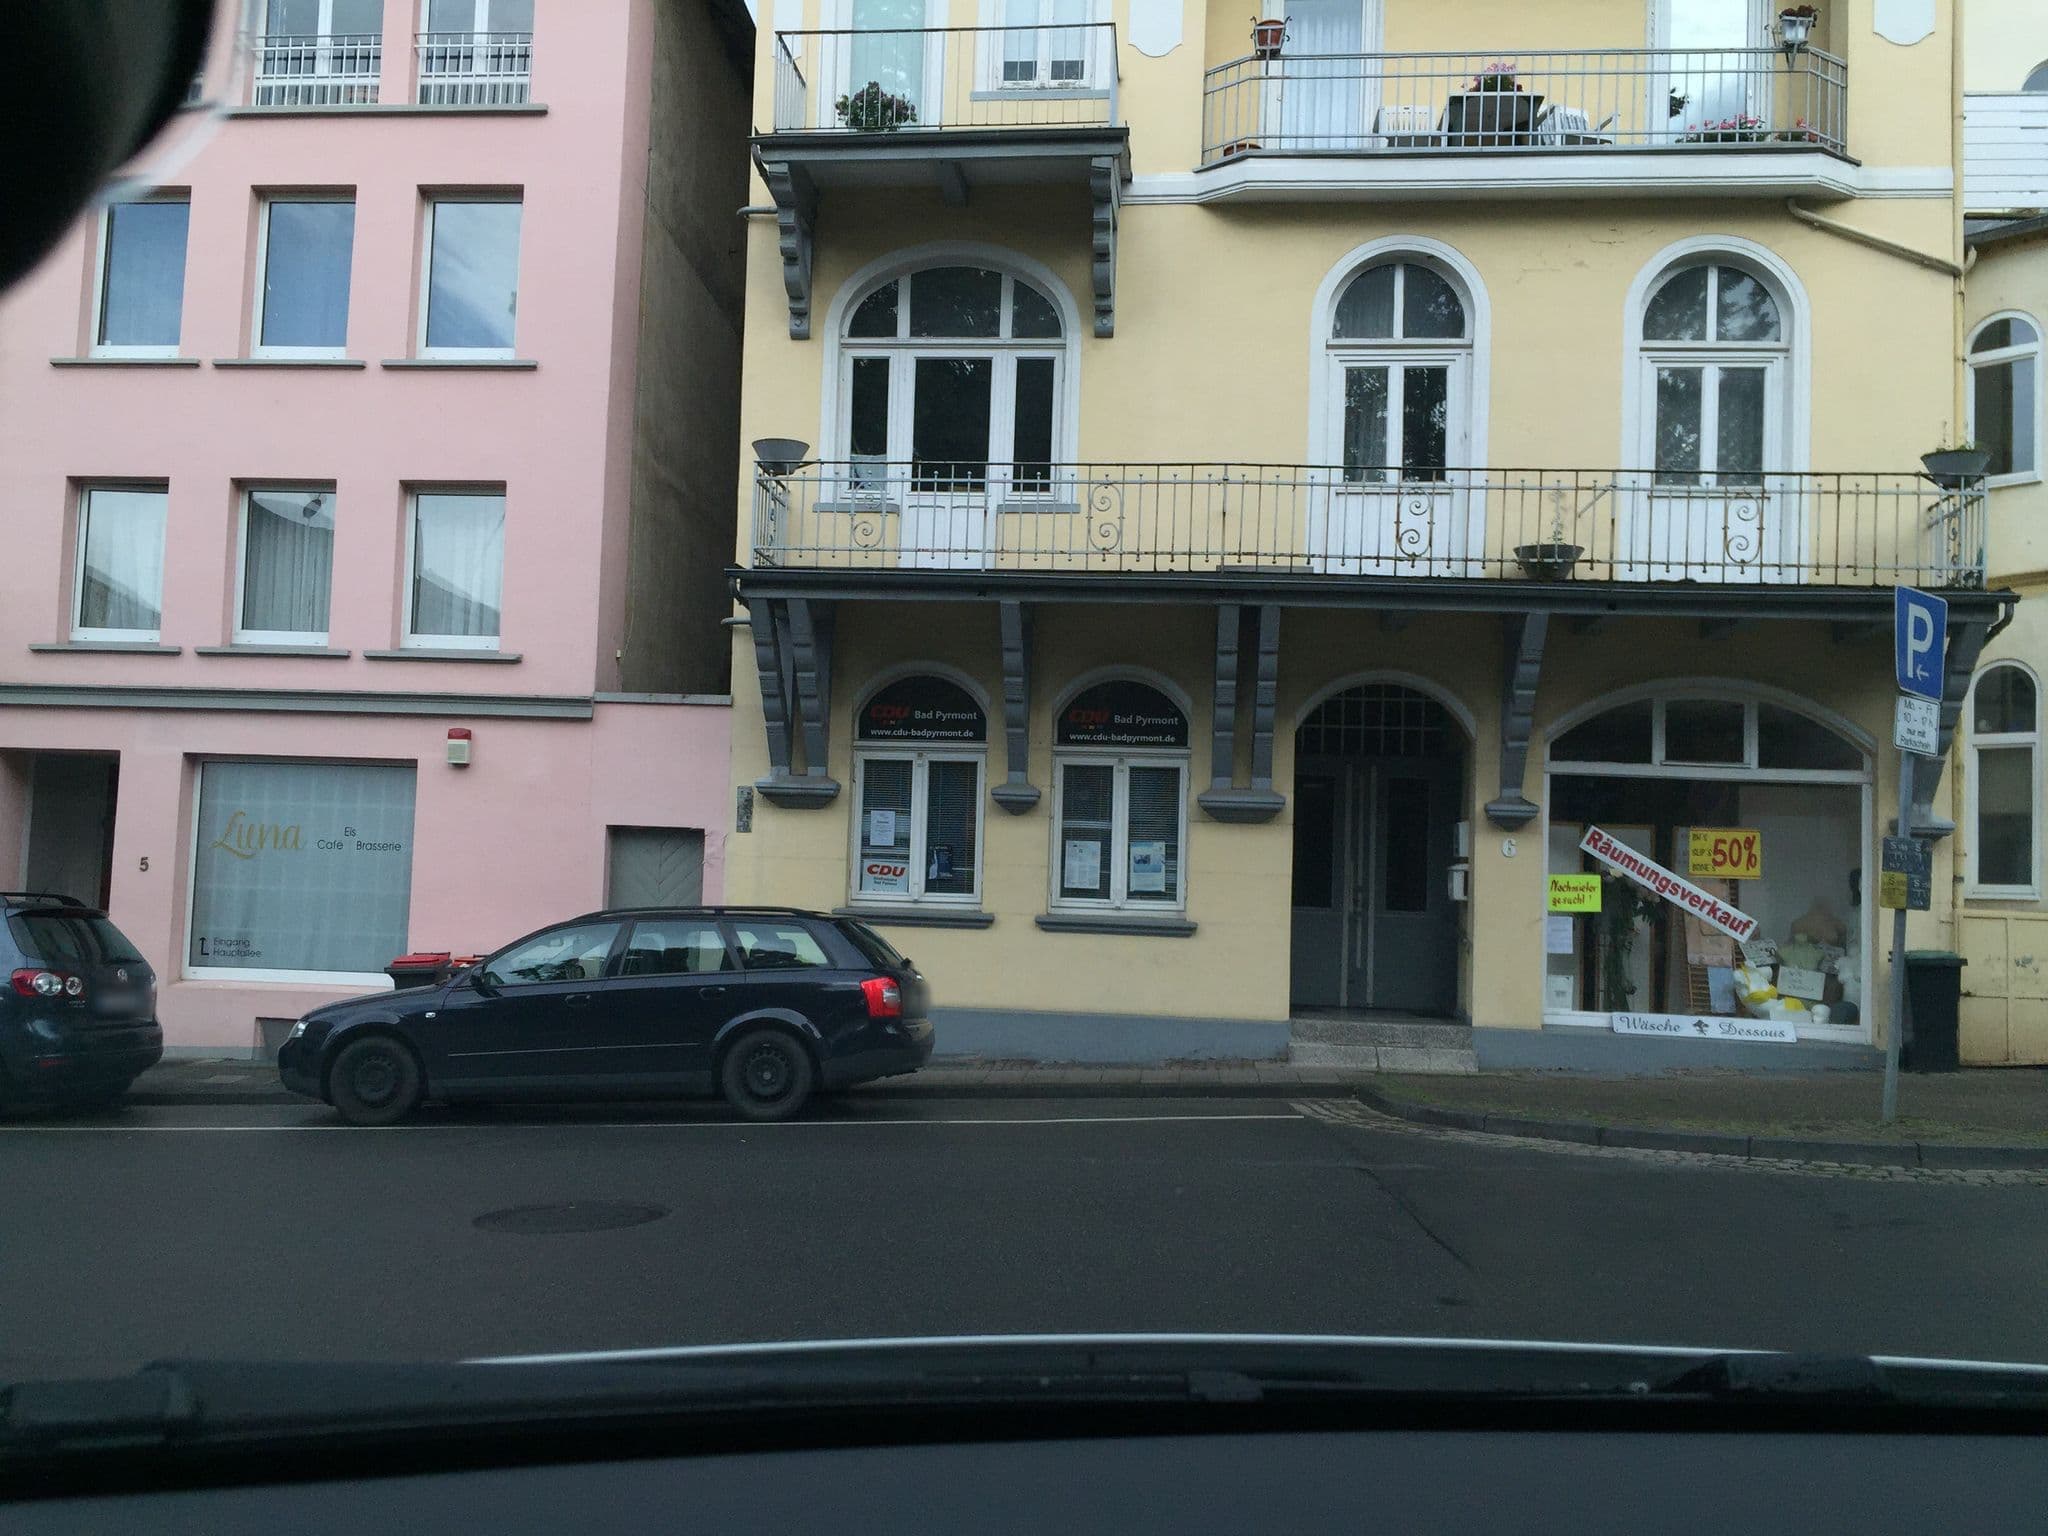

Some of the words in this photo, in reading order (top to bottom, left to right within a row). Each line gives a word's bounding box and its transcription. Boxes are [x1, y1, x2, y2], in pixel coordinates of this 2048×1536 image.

[1907, 603, 1934, 678] P
[870, 704, 910, 719] CDU
[914, 711, 932, 719] Bad
[936, 711, 977, 720] Pyrmont
[1068, 709, 1110, 723] CDU
[1114, 715, 1133, 724] Bad
[1136, 716, 1179, 726] Pyrmont
[870, 728, 974, 739] www.cdu-badpyrmont.de
[1069, 733, 1176, 744] www.cdu-badpyrmont.de
[210, 810, 304, 860] Luna
[344, 826, 357, 838] Eis
[356, 840, 402, 852] Brasserie
[1501, 838, 1517, 858] 6
[1712, 834, 1757, 871] 50%
[139, 856, 149, 872] 5
[867, 864, 906, 877] CDU
[1586, 829, 1753, 936] Räumungsverkauf
[213, 937, 250, 948] Eingang
[213, 947, 262, 958] Hauptallee
[1619, 1016, 1681, 1033] Wäsche
[1719, 1021, 1785, 1037] Dessous
